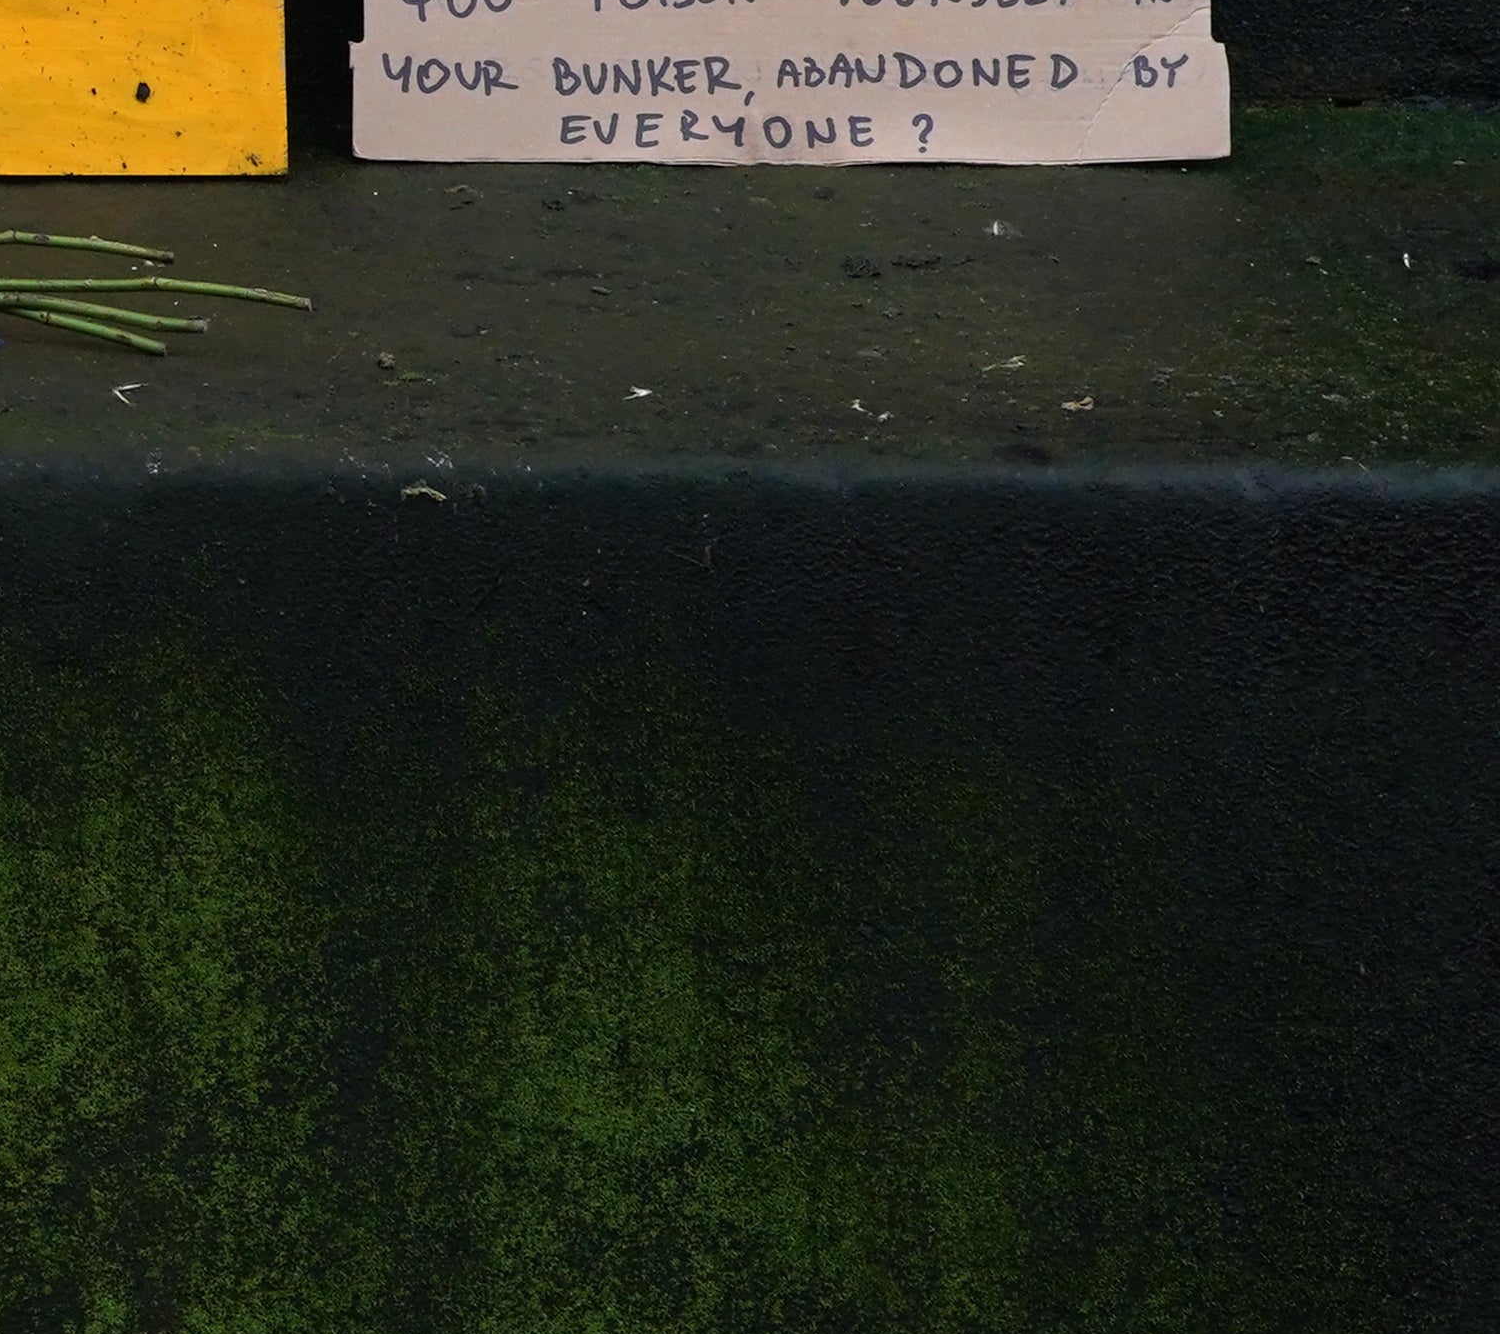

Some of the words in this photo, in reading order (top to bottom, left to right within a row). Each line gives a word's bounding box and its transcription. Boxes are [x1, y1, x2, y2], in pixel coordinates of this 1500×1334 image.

[381, 52, 519, 97] YOUR
[552, 56, 755, 107] BUNKER,
[776, 52, 1079, 90] ABANDONED
[1132, 53, 1189, 89] BY
